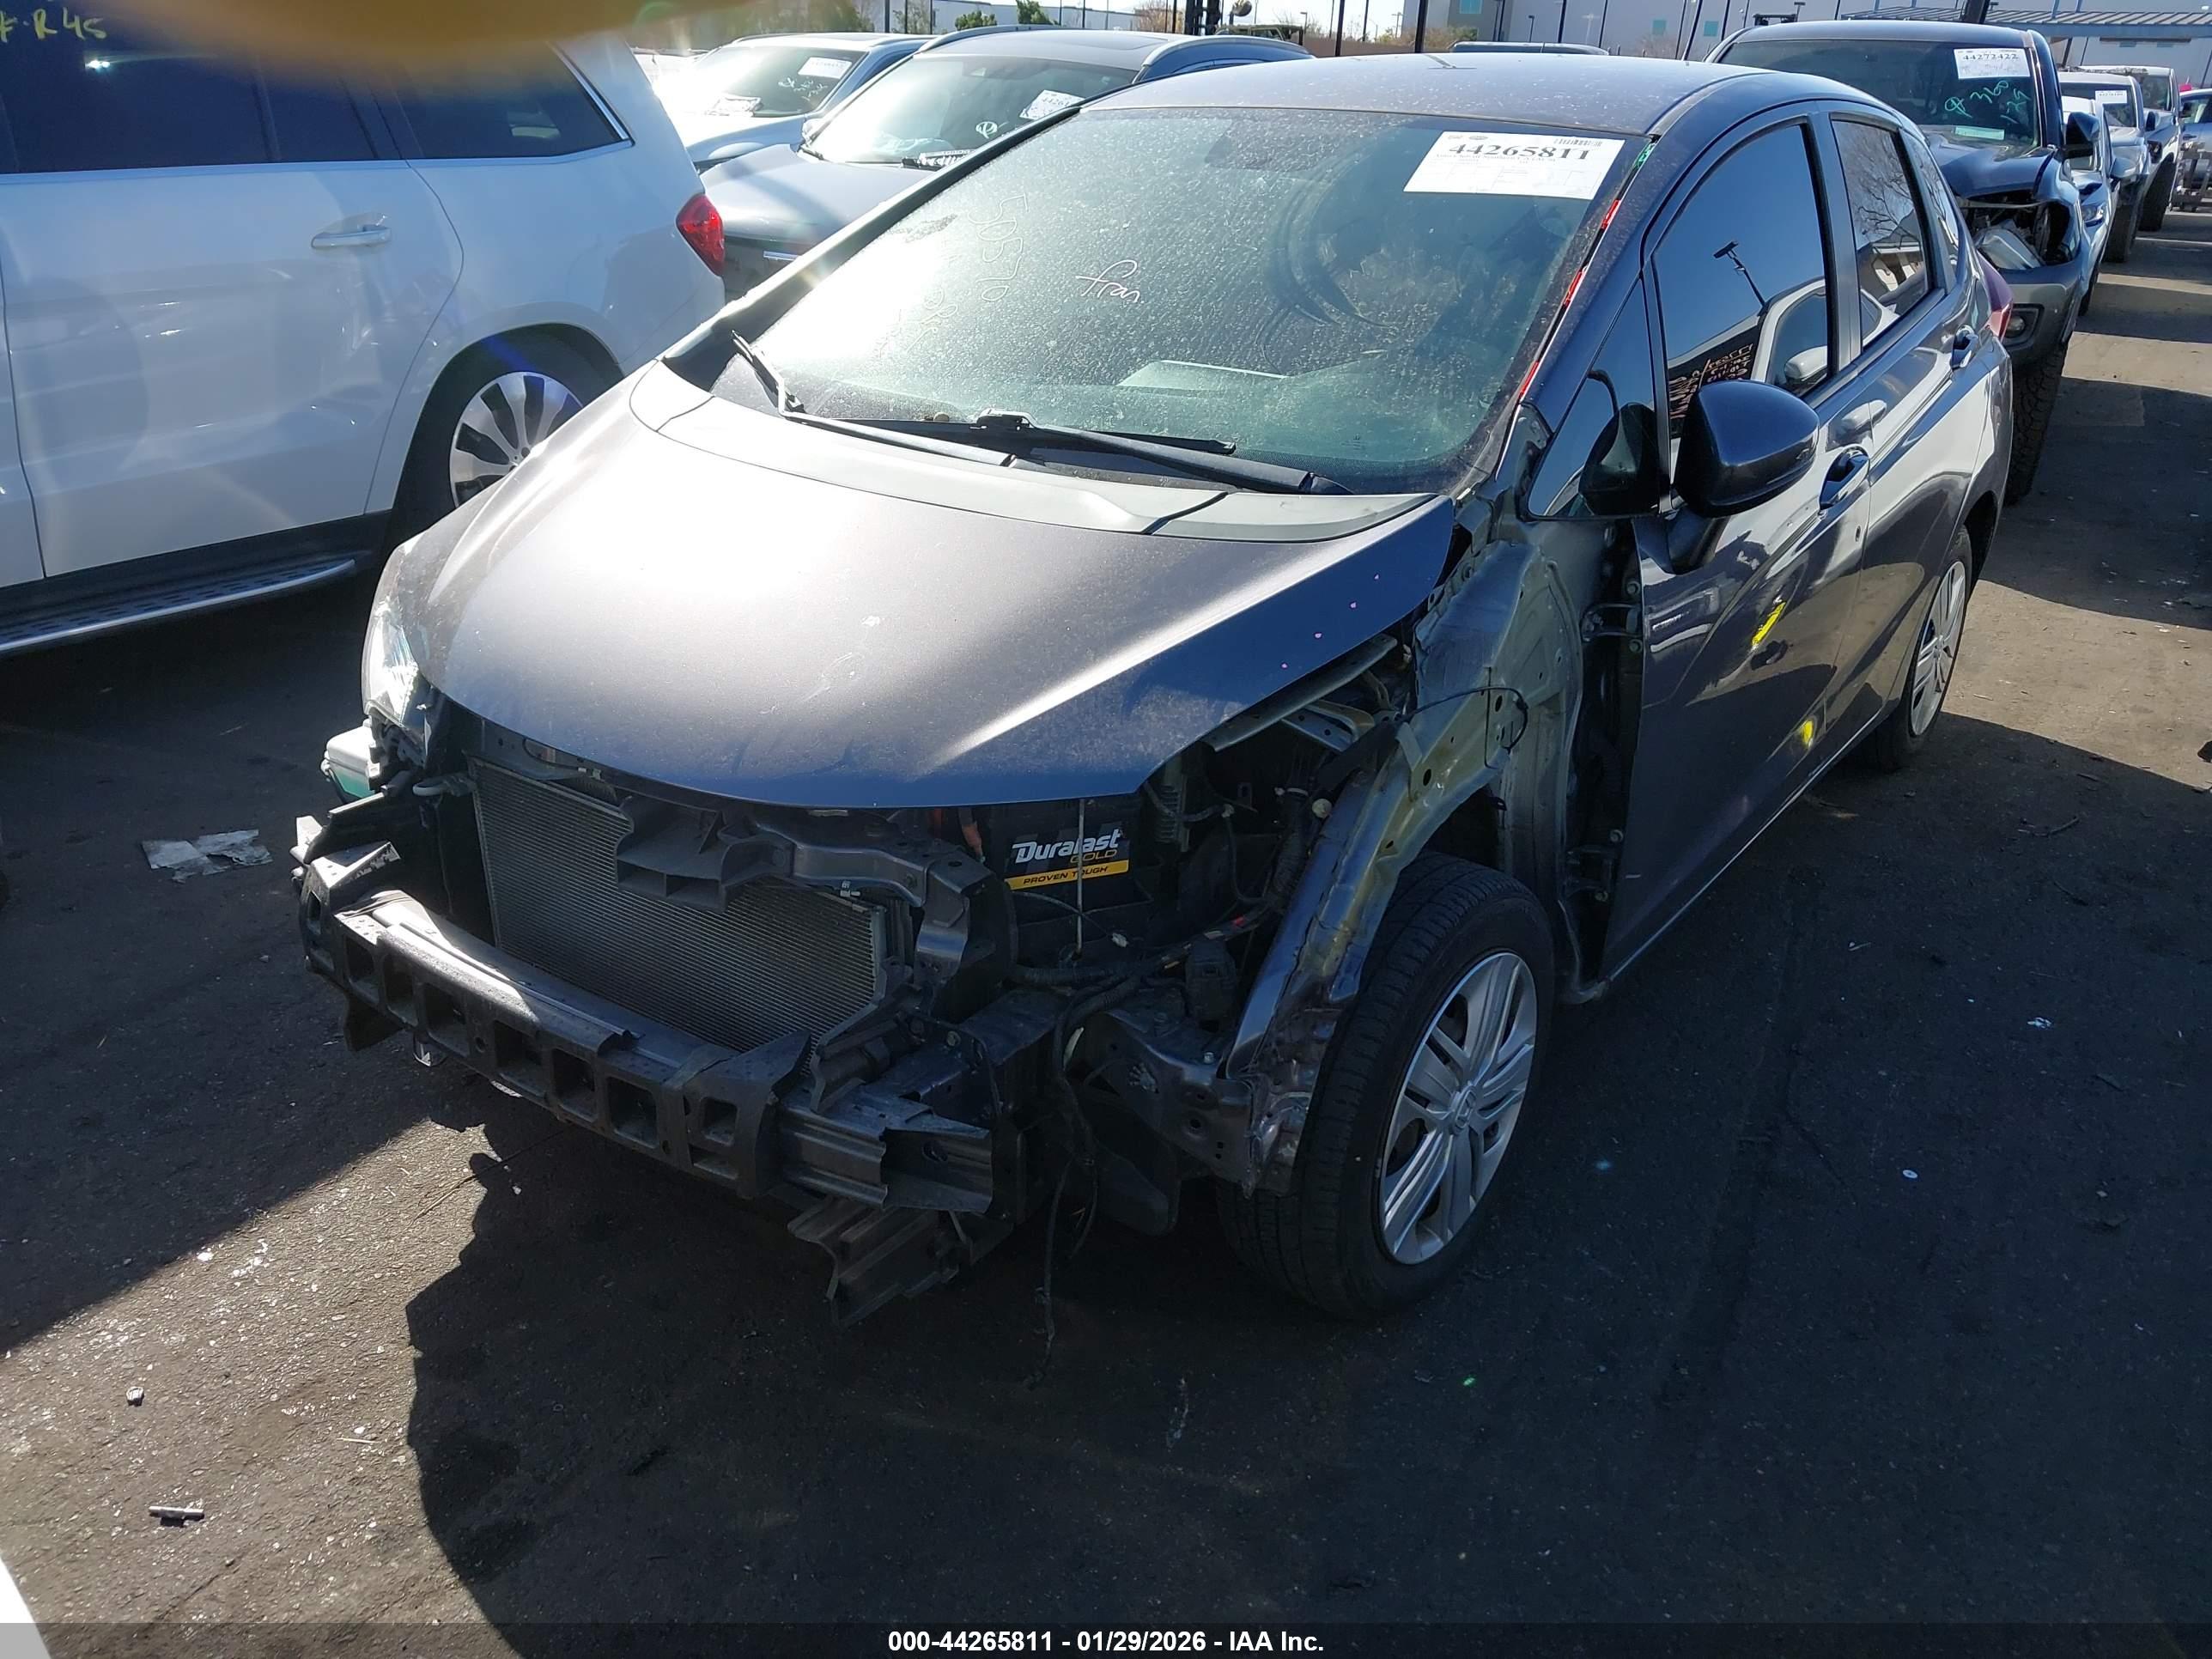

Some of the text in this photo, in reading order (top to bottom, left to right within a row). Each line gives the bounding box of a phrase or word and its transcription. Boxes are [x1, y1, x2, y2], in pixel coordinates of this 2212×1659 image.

[1962, 52, 2020, 61] 44272422
[1449, 143, 1590, 161] 44265811
[1012, 828, 1123, 864] Duralast
[1070, 848, 1118, 864] GOLD
[1023, 871, 1069, 885] PROVEN
